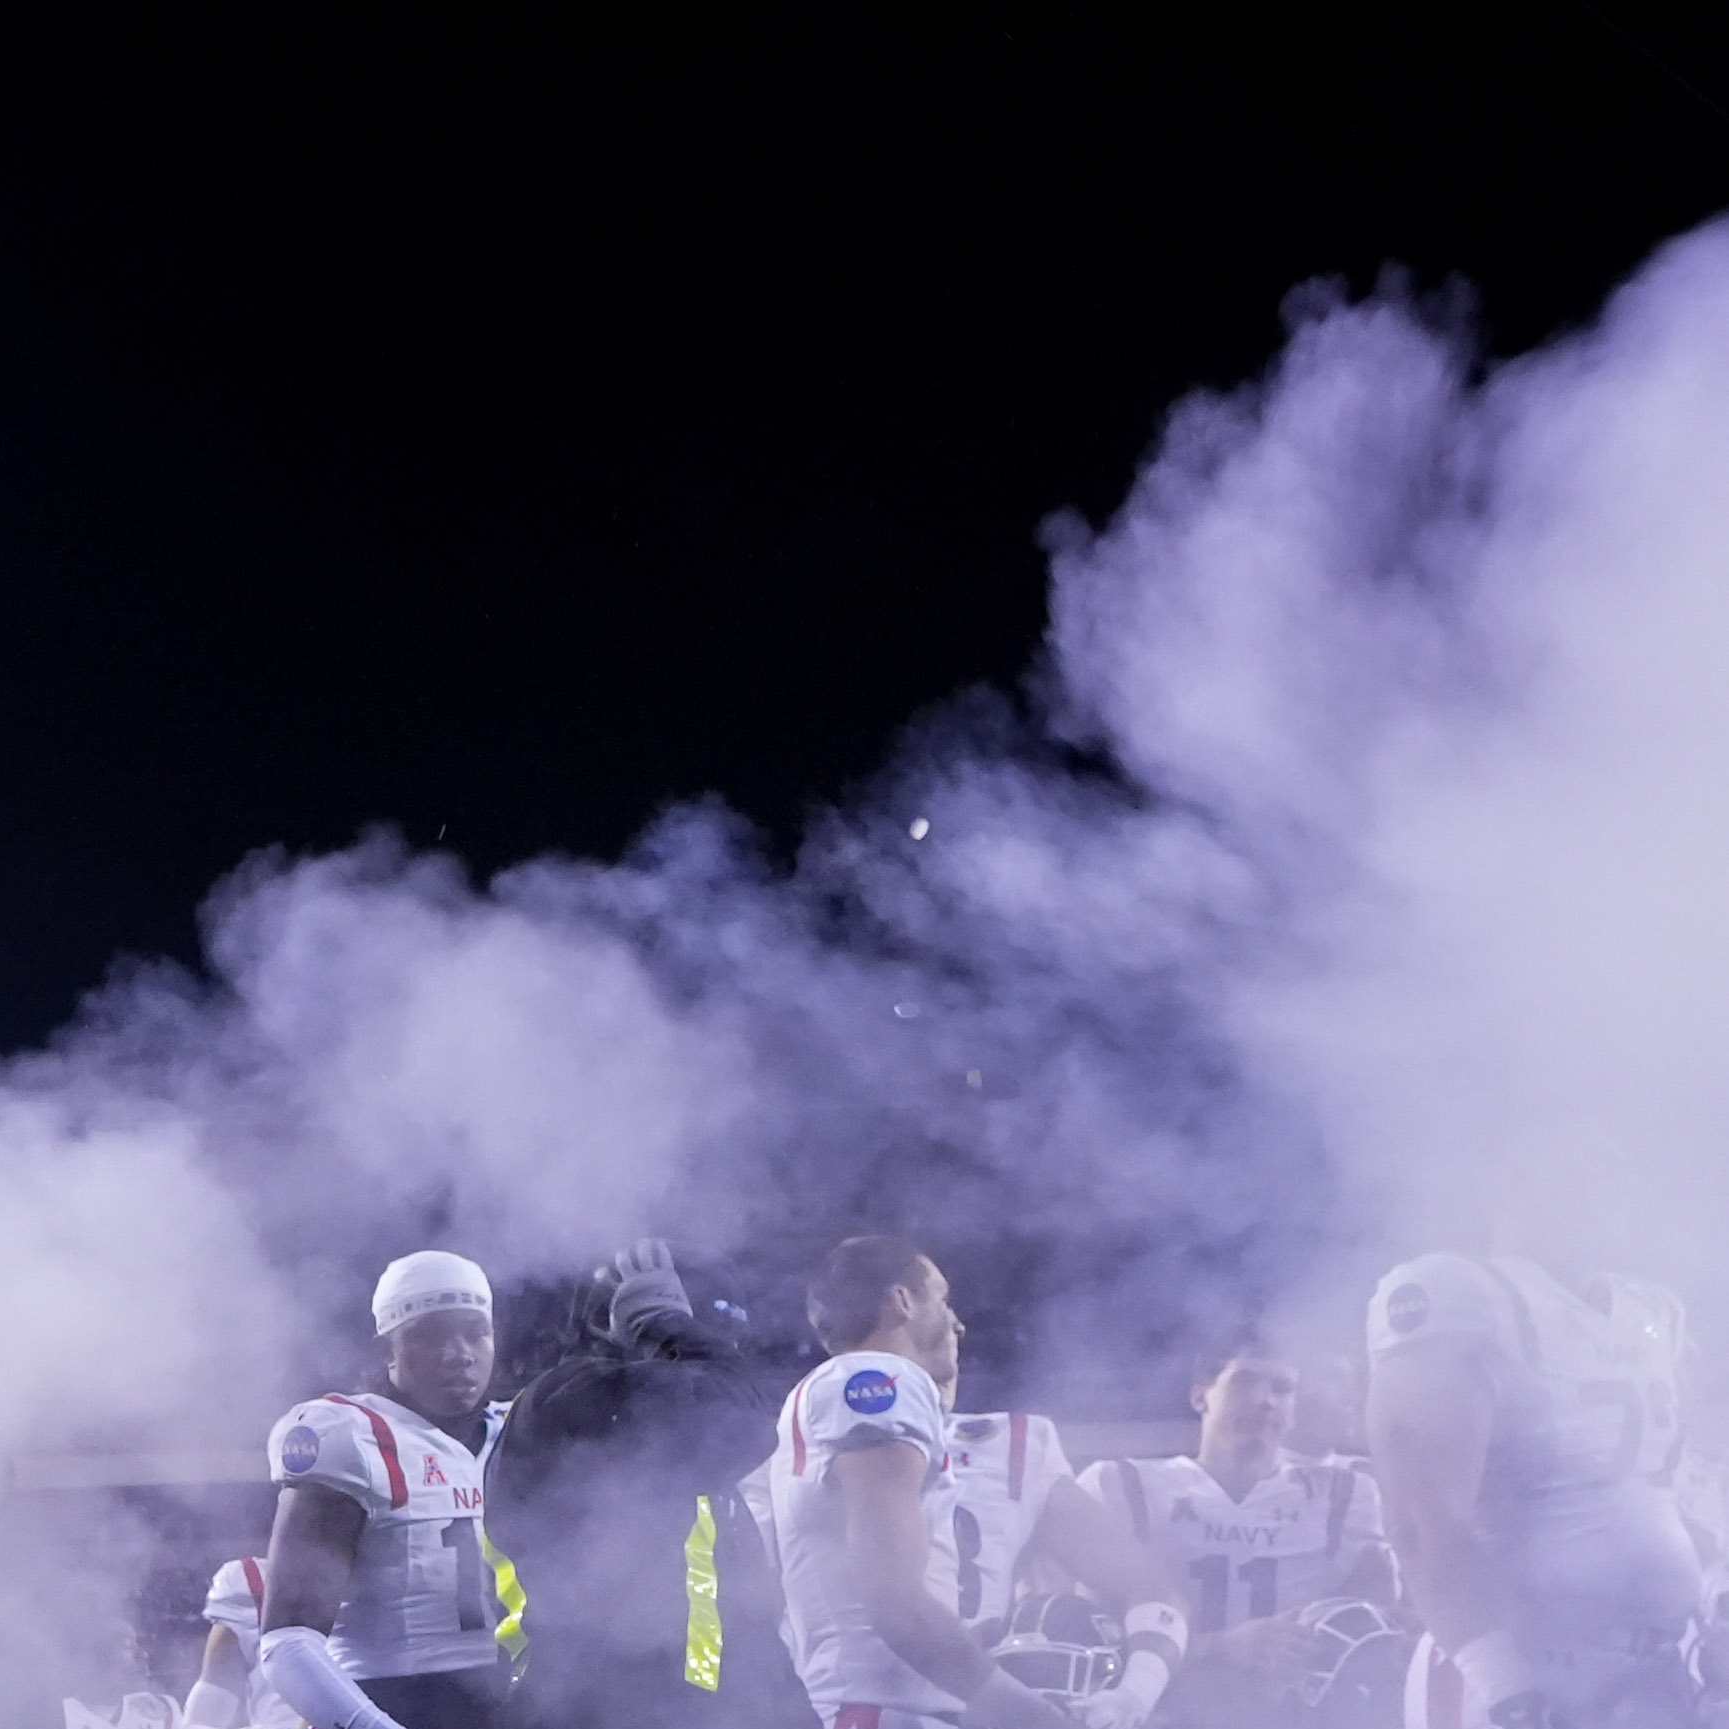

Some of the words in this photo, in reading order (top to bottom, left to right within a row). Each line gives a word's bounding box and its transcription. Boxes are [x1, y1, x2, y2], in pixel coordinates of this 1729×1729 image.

[846, 1385, 895, 1402] NASA
[453, 1488, 482, 1510] NA
[1205, 1522, 1282, 1546] NAVY
[1189, 1553, 1278, 1634] 11
